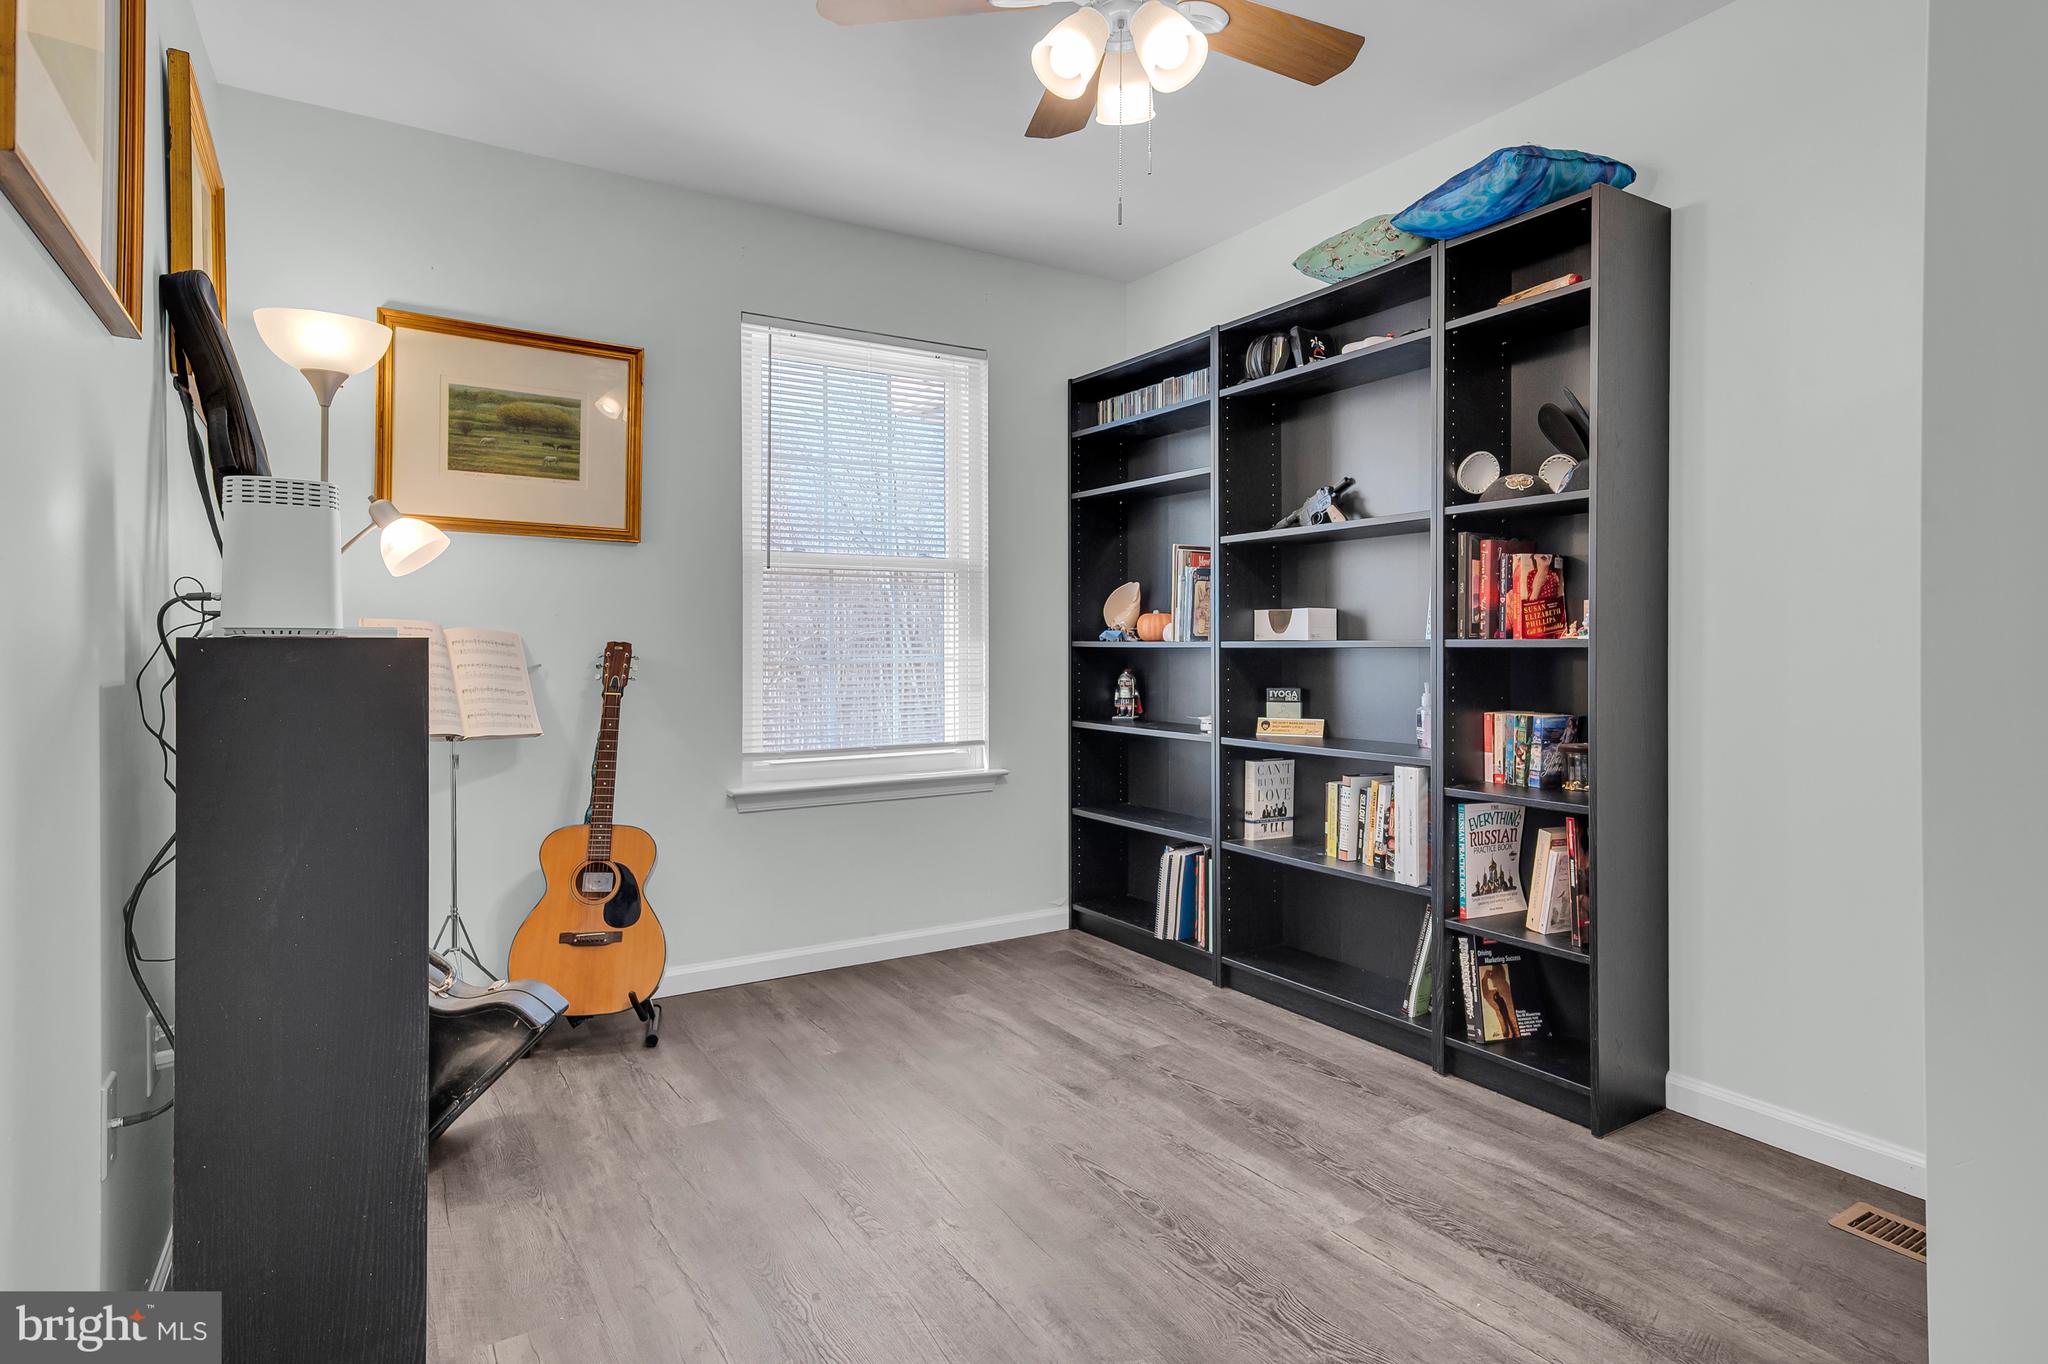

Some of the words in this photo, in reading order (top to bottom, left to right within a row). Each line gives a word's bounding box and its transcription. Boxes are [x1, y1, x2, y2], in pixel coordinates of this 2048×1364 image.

[1523, 603, 1547, 614] SUSAN
[1524, 608, 1561, 621] ELIZABETH
[1525, 617, 1557, 629] PHILLIPS
[1257, 763, 1291, 776] CAN'T
[1257, 788, 1291, 802] LOVE
[1358, 793, 1367, 824] SELLOUT
[1469, 810, 1521, 831] EVERYTHING
[1469, 828, 1518, 848] RUSSIAN
[1473, 845, 1497, 854] PRACTICE
[1498, 843, 1513, 851] BOOK
[1484, 956, 1505, 964] Marketing
